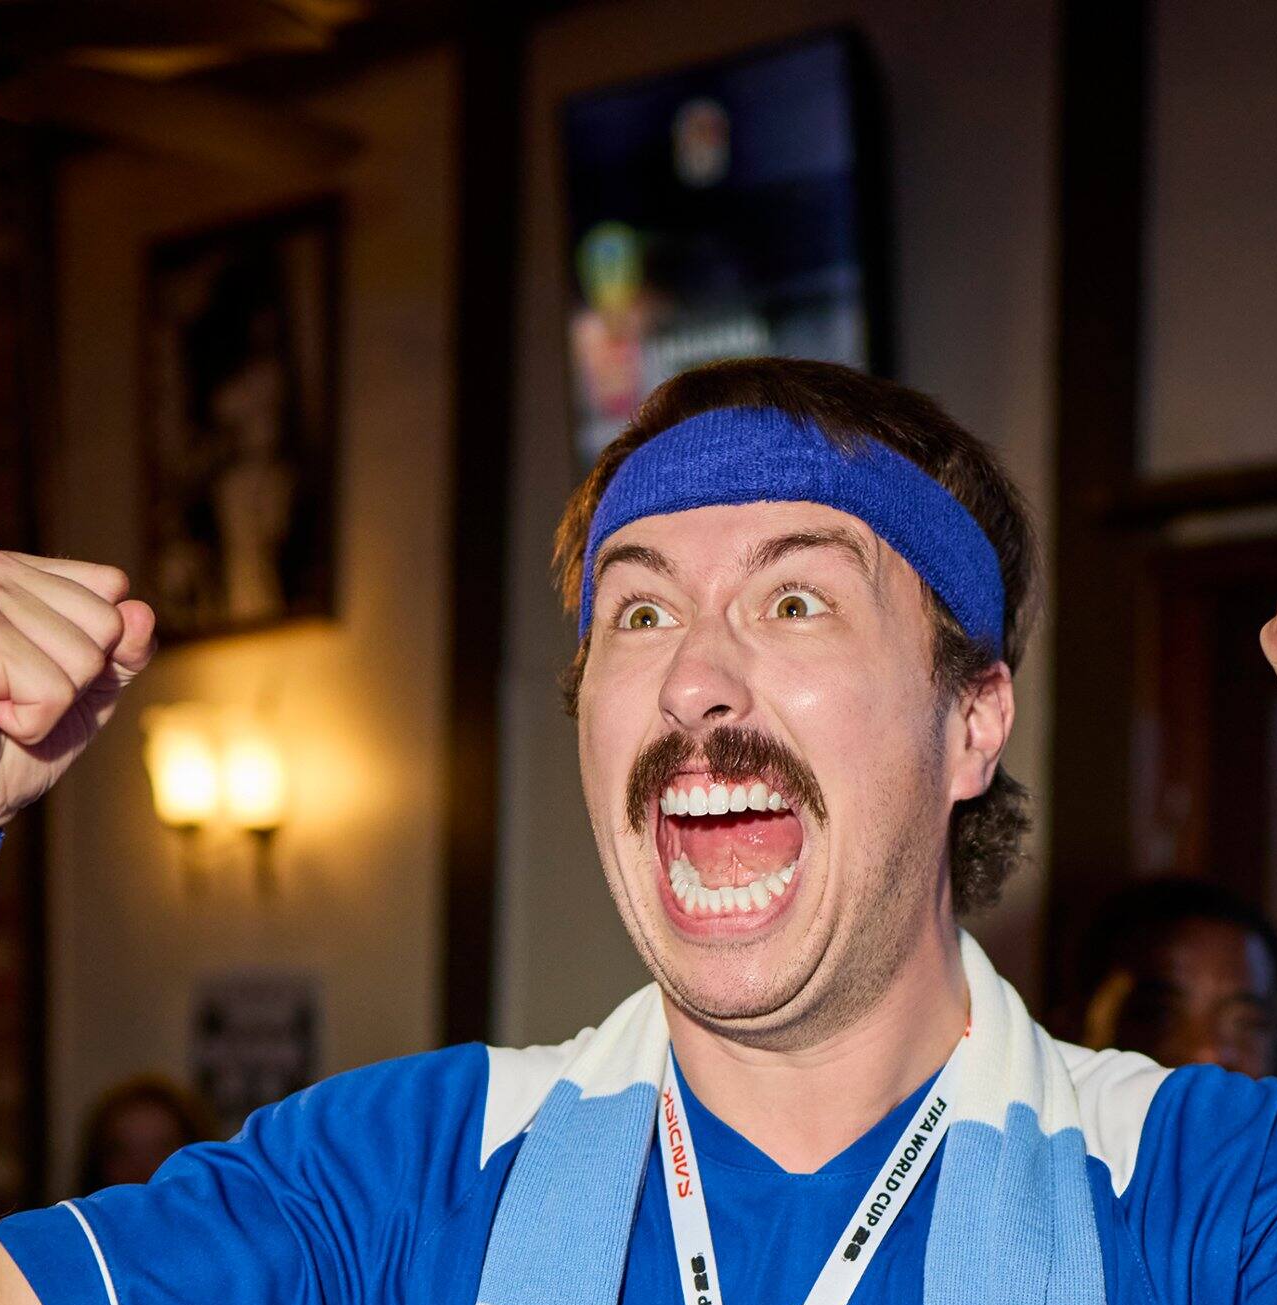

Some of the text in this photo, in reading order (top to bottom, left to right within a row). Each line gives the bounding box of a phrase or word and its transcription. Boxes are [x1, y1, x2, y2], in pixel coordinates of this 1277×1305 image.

[919, 1096, 948, 1132] FIFA
[885, 1133, 928, 1192] WORLD
[865, 1192, 892, 1227] CUP
